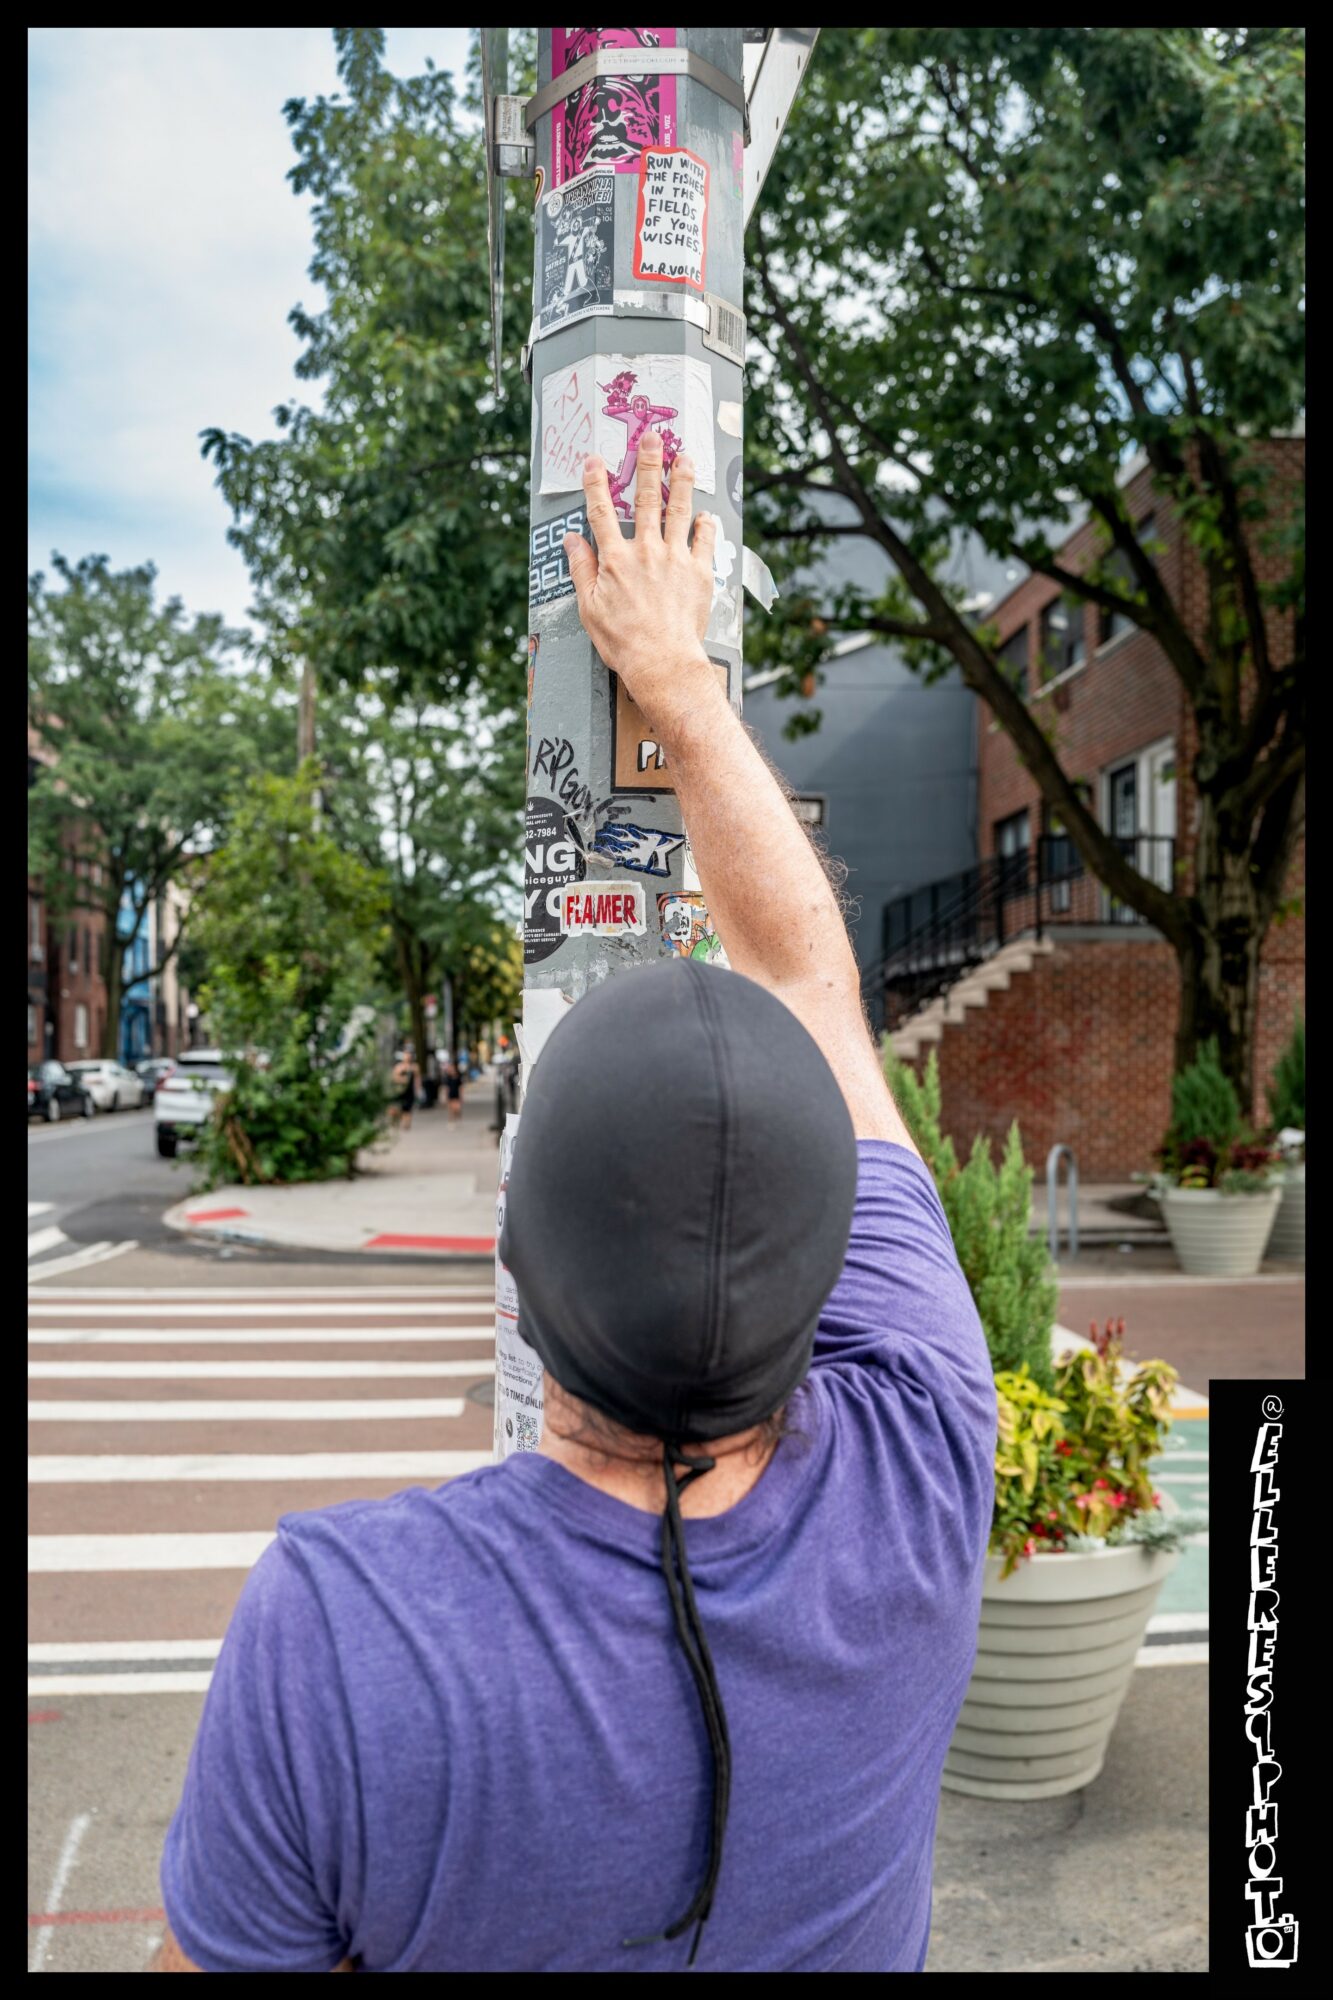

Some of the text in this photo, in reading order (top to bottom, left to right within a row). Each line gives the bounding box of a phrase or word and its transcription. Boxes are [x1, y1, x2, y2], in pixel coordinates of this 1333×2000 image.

[647, 155, 705, 178] RUN WITH
[587, 177, 613, 195] NINJA
[646, 172, 705, 195] THE FISHES
[651, 185, 695, 201] IN THE
[648, 199, 697, 220] FIELDS
[644, 215, 661, 227] OF
[643, 231, 701, 255] WISHES.
[566, 893, 637, 929] FLAMER
[509, 1389, 524, 1403] TIME
